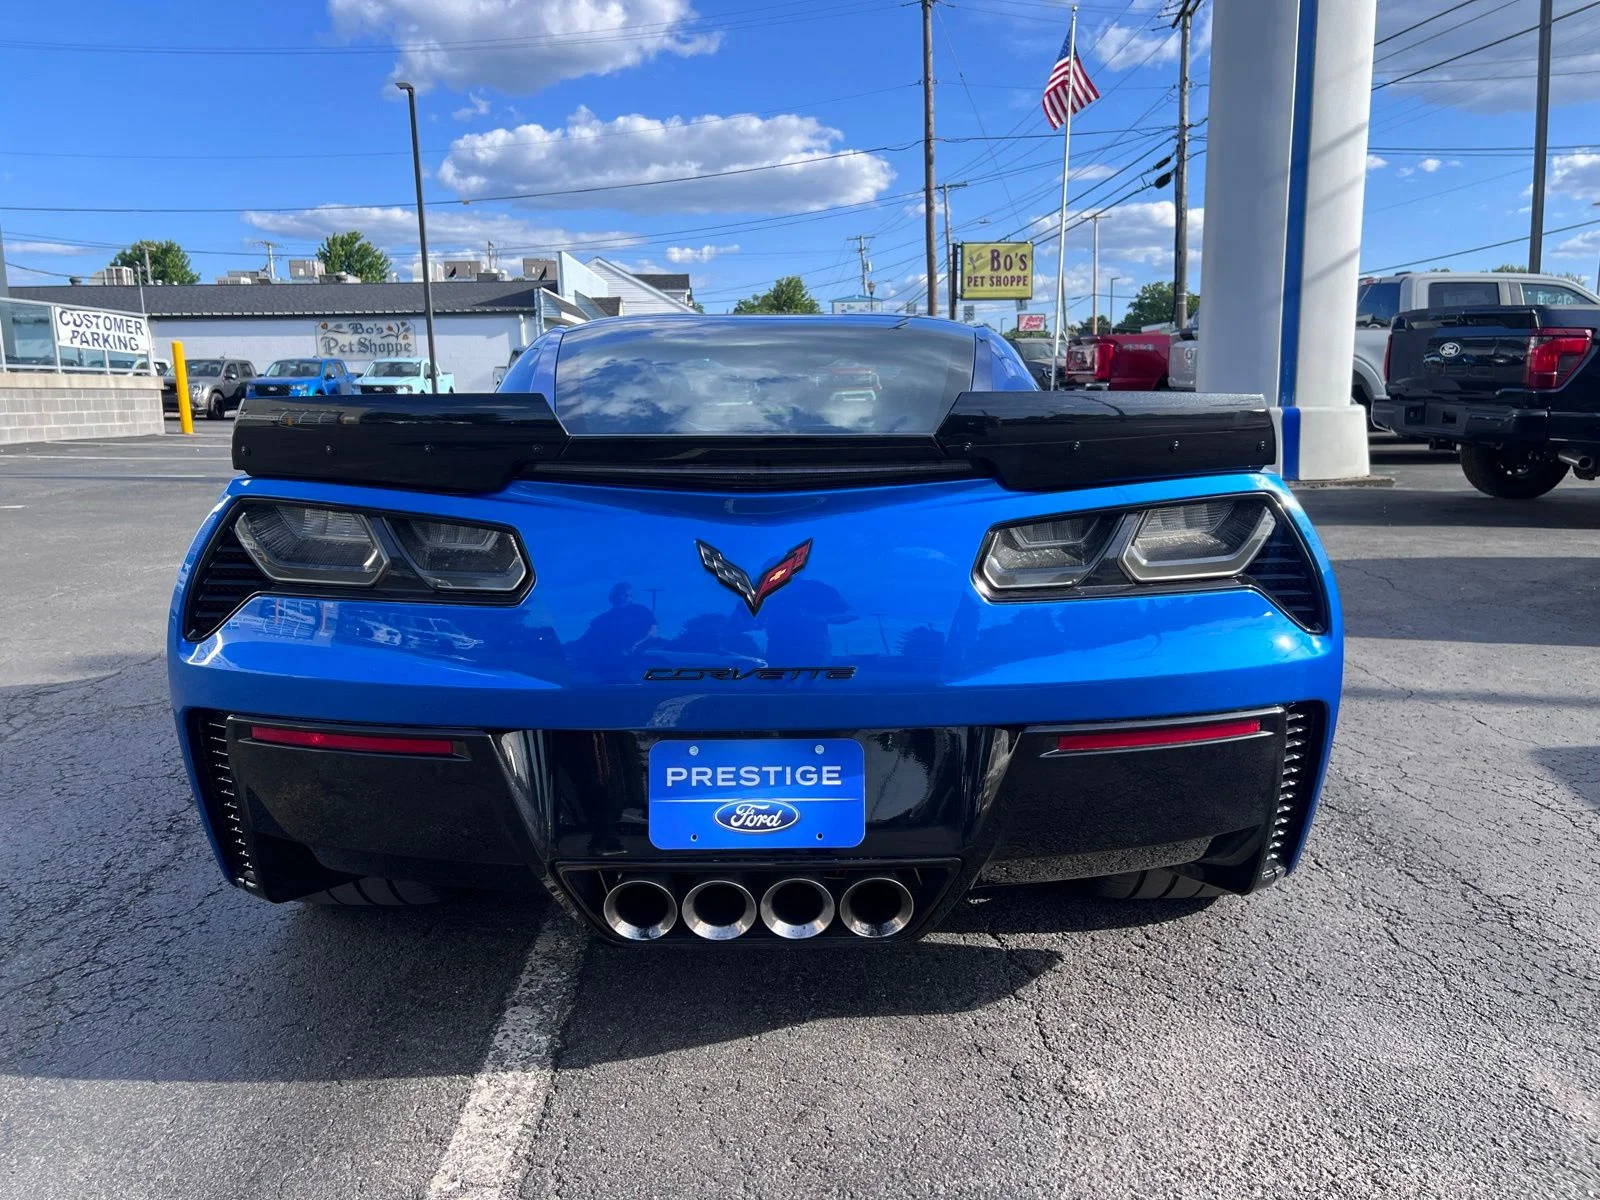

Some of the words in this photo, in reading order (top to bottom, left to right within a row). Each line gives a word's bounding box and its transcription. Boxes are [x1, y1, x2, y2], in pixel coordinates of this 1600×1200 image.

[990, 249, 1028, 272] Bo's
[967, 276, 986, 288] PET
[989, 275, 1029, 288] SHOPPE
[59, 310, 145, 336] CUSTOMER
[348, 322, 384, 335] Bo's
[70, 330, 140, 351] PARKING
[320, 336, 354, 356] Pet
[356, 337, 413, 357] Shoppe
[643, 666, 857, 681] CORVETTE
[666, 765, 842, 787] PRESTIGE
[730, 803, 783, 827] Ford
